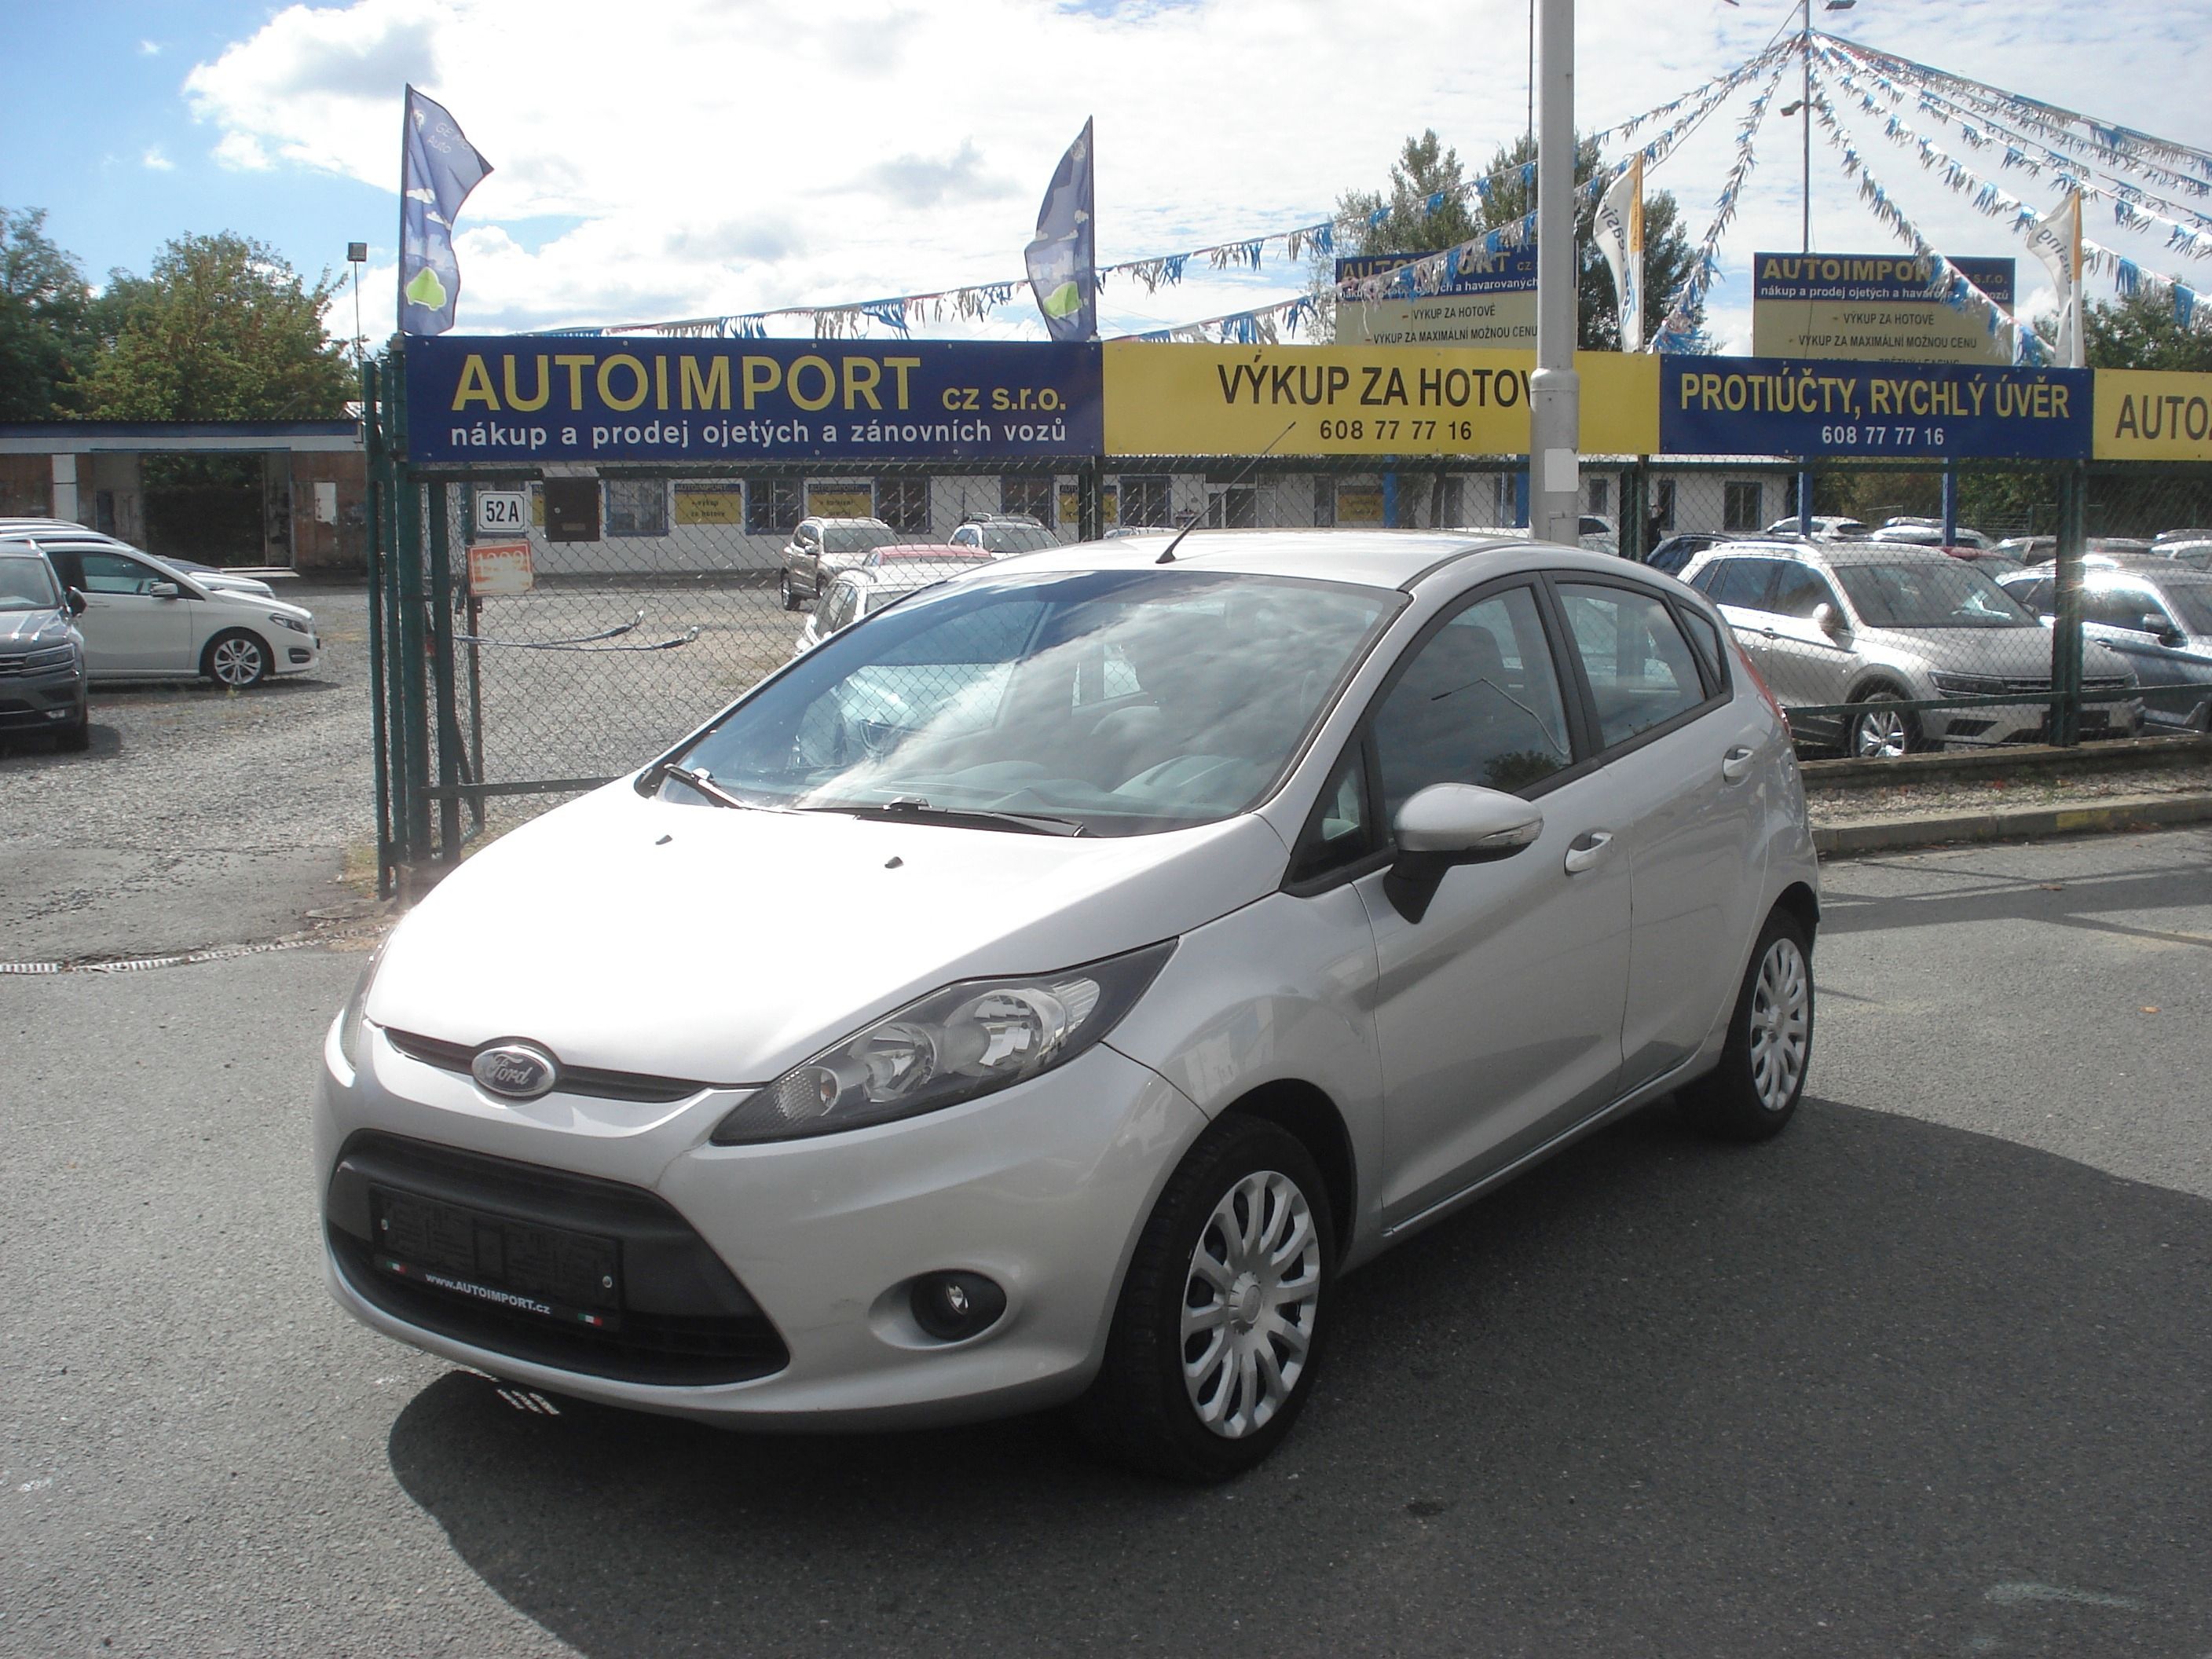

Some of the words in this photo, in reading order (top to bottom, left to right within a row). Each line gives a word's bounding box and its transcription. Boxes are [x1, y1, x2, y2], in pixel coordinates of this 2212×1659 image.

[1763, 258, 1939, 282] AUTOIMPOR
[1760, 286, 1796, 298] nákup
[1799, 288, 1807, 297] a
[1809, 287, 1846, 298] prodej
[1848, 287, 1889, 299] ojetých
[1892, 289, 1899, 298] a
[1444, 307, 1456, 318] ZA
[1879, 314, 1892, 324] ZA
[1405, 331, 1416, 342] ZA
[1834, 335, 1848, 346] ZA
[1950, 337, 1977, 348] CENU
[451, 354, 921, 411] AUTOIMPORT
[943, 388, 980, 410] cz
[991, 387, 1067, 411] s.r.o.
[1218, 354, 1350, 405] VÝKUP
[1360, 366, 1409, 406] ZA
[1681, 366, 1861, 420] PROTIÚČTY,
[1871, 373, 1987, 418] RYCHLÝ
[1995, 376, 2069, 419] ÚVĚR
[2115, 394, 2212, 440] AUTO
[452, 420, 547, 450] nákup
[562, 427, 577, 445] a
[593, 421, 689, 449] prodej
[703, 421, 810, 449] ojetých
[823, 426, 838, 442] a
[851, 418, 991, 443] zánovních
[1004, 417, 1067, 442] vozů
[1319, 419, 1364, 441] 608
[1375, 420, 1400, 440] 77
[1412, 420, 1437, 440] 77
[1448, 420, 1472, 440] 16
[1822, 426, 1858, 445] 608
[1866, 427, 1886, 445] 77
[1895, 427, 1915, 445] 77
[1924, 427, 1945, 445] 16
[486, 500, 504, 522] 52
[508, 501, 519, 522] A
[489, 1053, 533, 1086] Ford
[425, 1273, 551, 1315] www.AUTOIMPORT.cz
